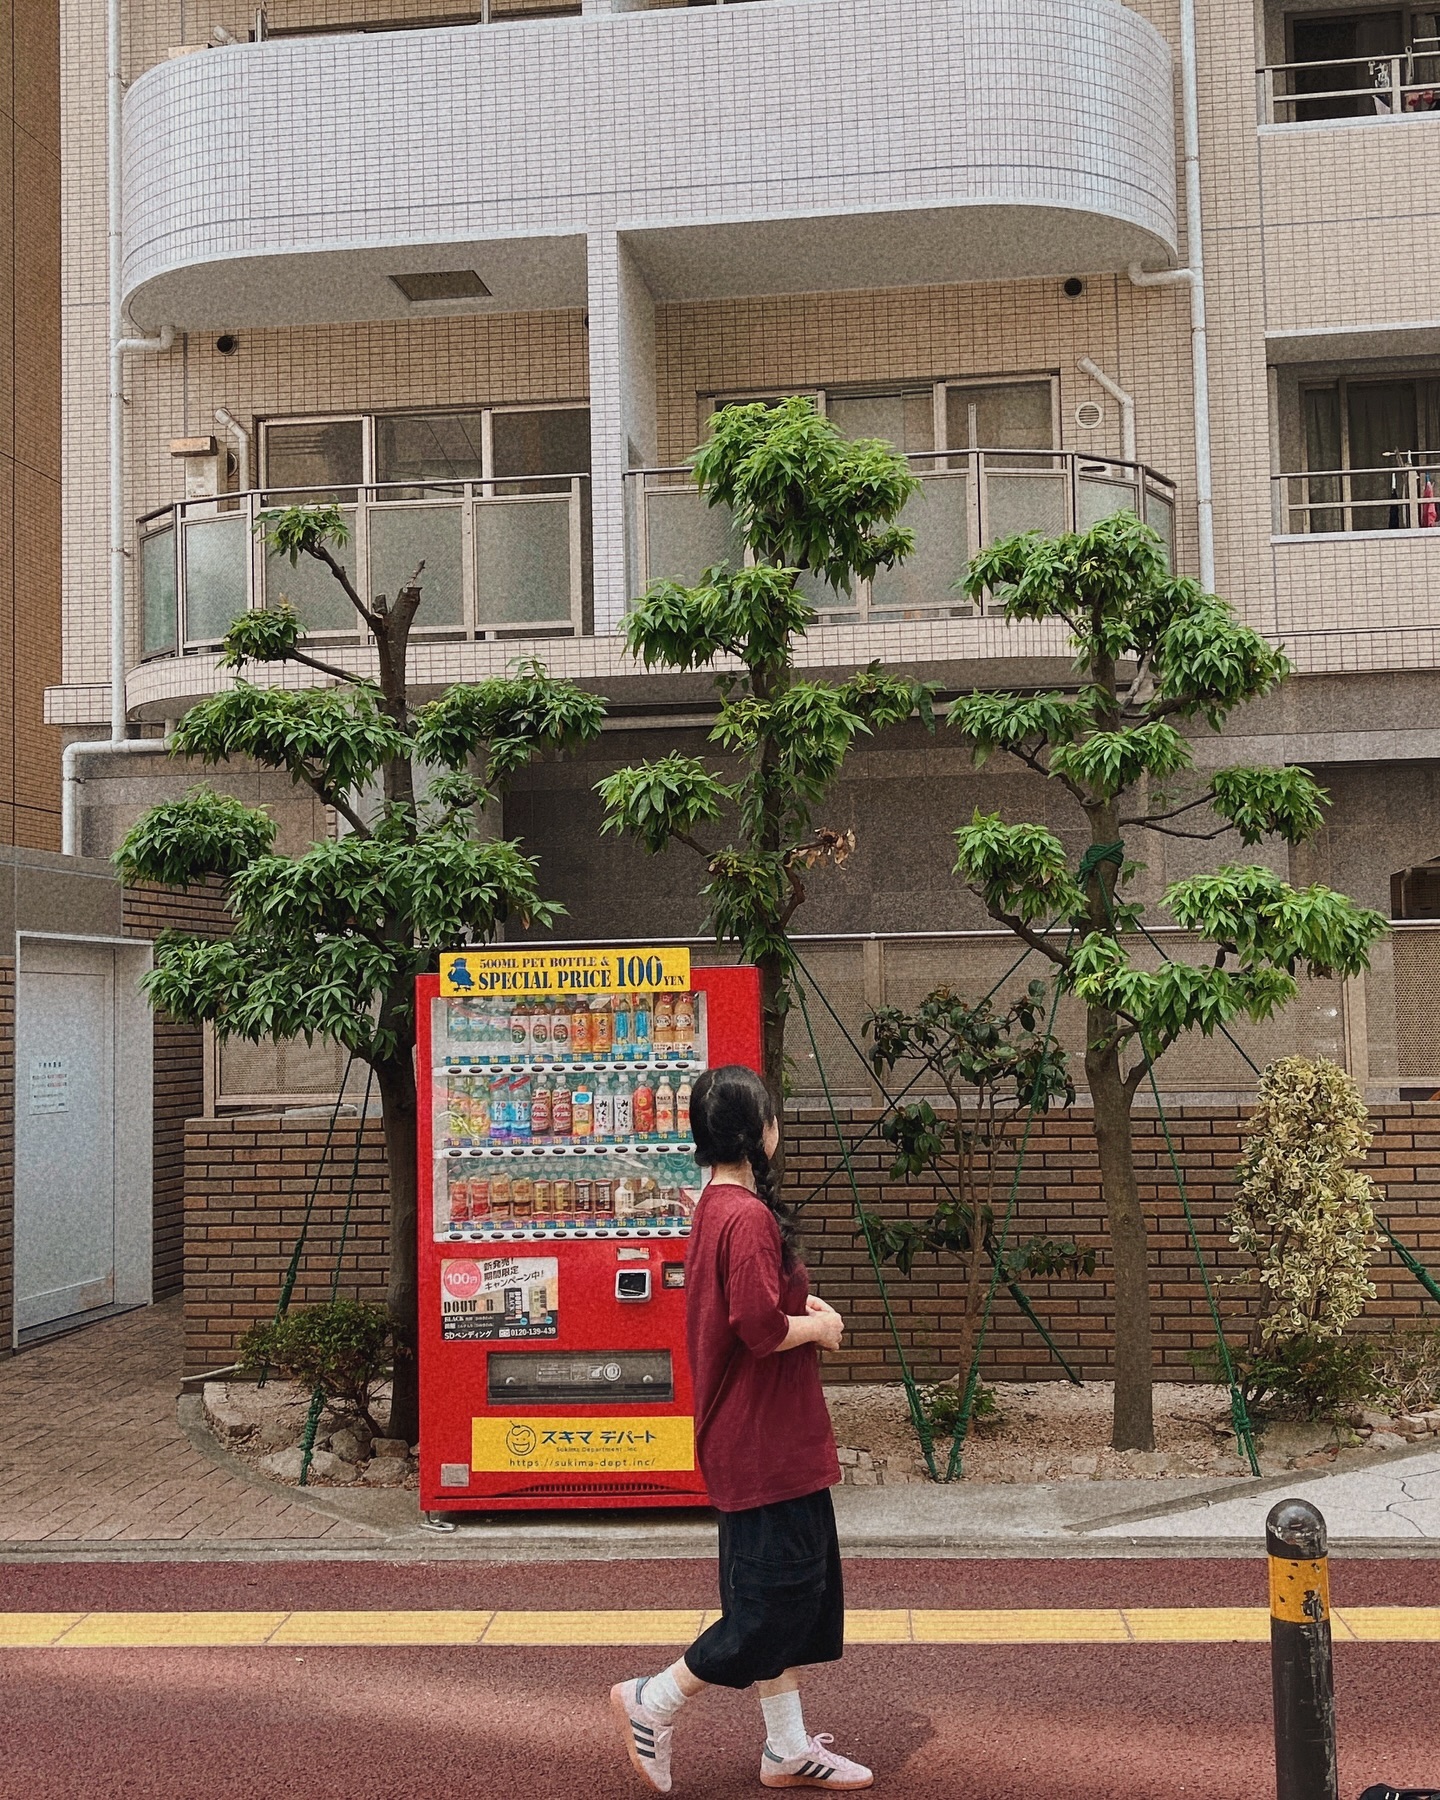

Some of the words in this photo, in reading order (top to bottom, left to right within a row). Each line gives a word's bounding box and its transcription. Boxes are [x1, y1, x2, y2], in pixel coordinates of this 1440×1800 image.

[479, 958, 519, 969] 500ML
[522, 957, 547, 968] PET
[550, 956, 597, 967] BOTTLE
[600, 956, 610, 967] &
[478, 970, 552, 991] SPECIAL
[557, 969, 612, 989] PRICE
[616, 955, 663, 987] 100
[663, 975, 685, 986] YEN
[510, 1327, 556, 1337] 0120-139-439
[541, 1430, 594, 1444] スキマ
[600, 1430, 656, 1444] デパート
[509, 1458, 656, 1468] https://sukima-dept.inc/
